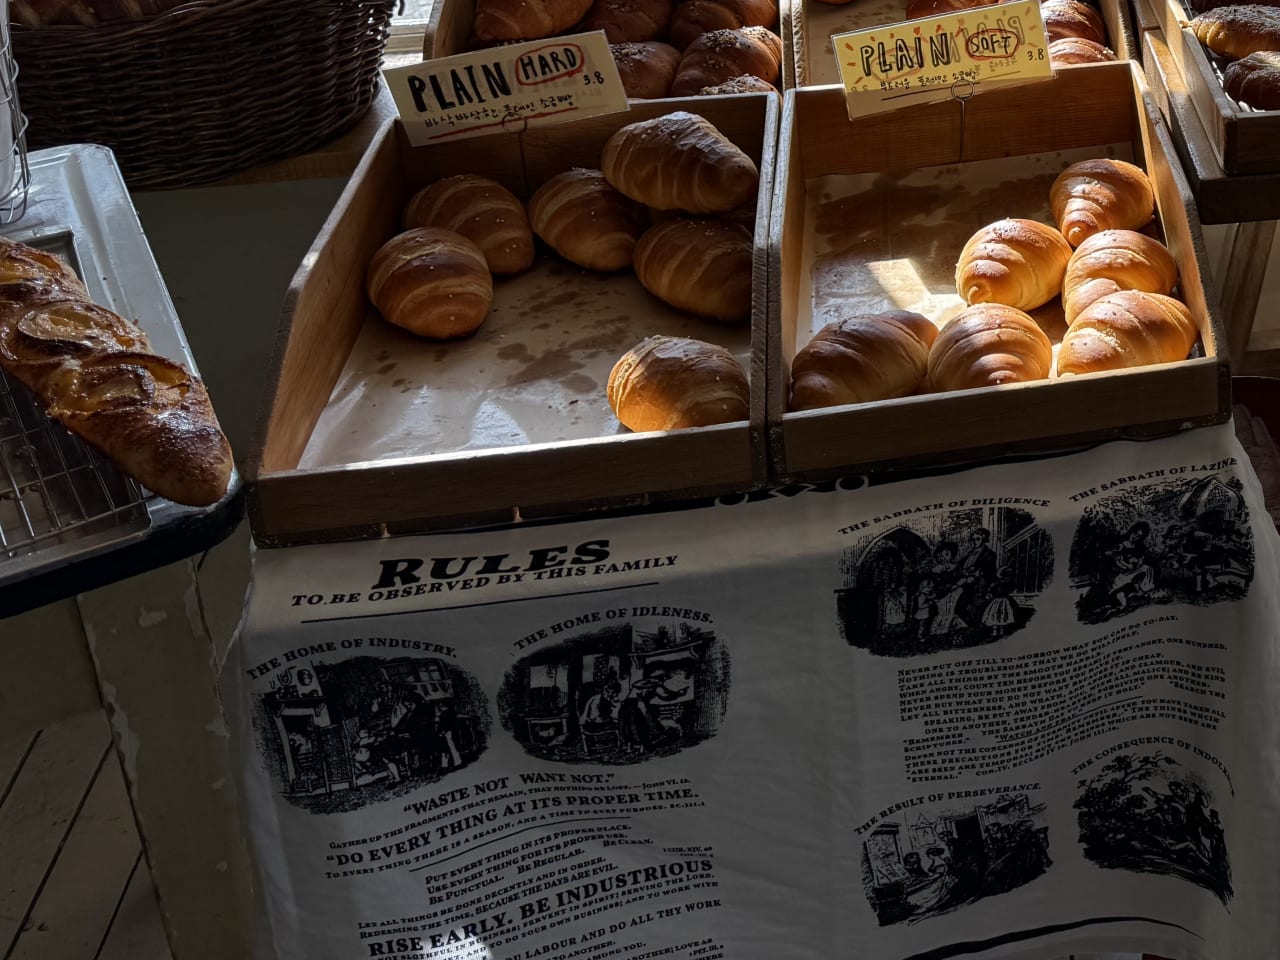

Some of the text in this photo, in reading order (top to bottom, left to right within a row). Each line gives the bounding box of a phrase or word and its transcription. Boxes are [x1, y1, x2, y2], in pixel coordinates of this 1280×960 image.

[860, 33, 951, 76] PLAIN
[970, 33, 1012, 54] SOFT
[408, 62, 512, 112] PLAIN
[519, 47, 577, 80] HARD
[879, 78, 911, 92] 부드러운
[425, 107, 498, 127] 바삭바삭한
[540, 93, 573, 108] 소금빵
[1069, 488, 1099, 503] THE
[1101, 470, 1165, 491] SABBATH
[1169, 466, 1187, 475] OF
[837, 497, 1050, 536] THE SABBATH OF DILIGENCE
[291, 555, 678, 607] TO BE OBSERVED BY THIS FAMILY
[371, 540, 611, 590] RULES
[513, 606, 714, 651] THE HOME OF IDLENESS.
[246, 637, 457, 680] THE HOME OF INDUSTRY.
[1071, 736, 1192, 775] THE CONSEQUENCE OF
[474, 777, 509, 796] NOT
[519, 773, 566, 784] WANT
[368, 831, 431, 862] EVERY
[435, 808, 498, 839] THING
[502, 801, 526, 817] AT
[530, 795, 562, 811] ITS
[566, 792, 641, 806] PROPER
[644, 789, 699, 800] TIME.
[853, 782, 1042, 836] THE RESULT OF PERSEVERANCE.
[368, 859, 713, 957] RISE EARLY. BE INDUSTRIOUS
